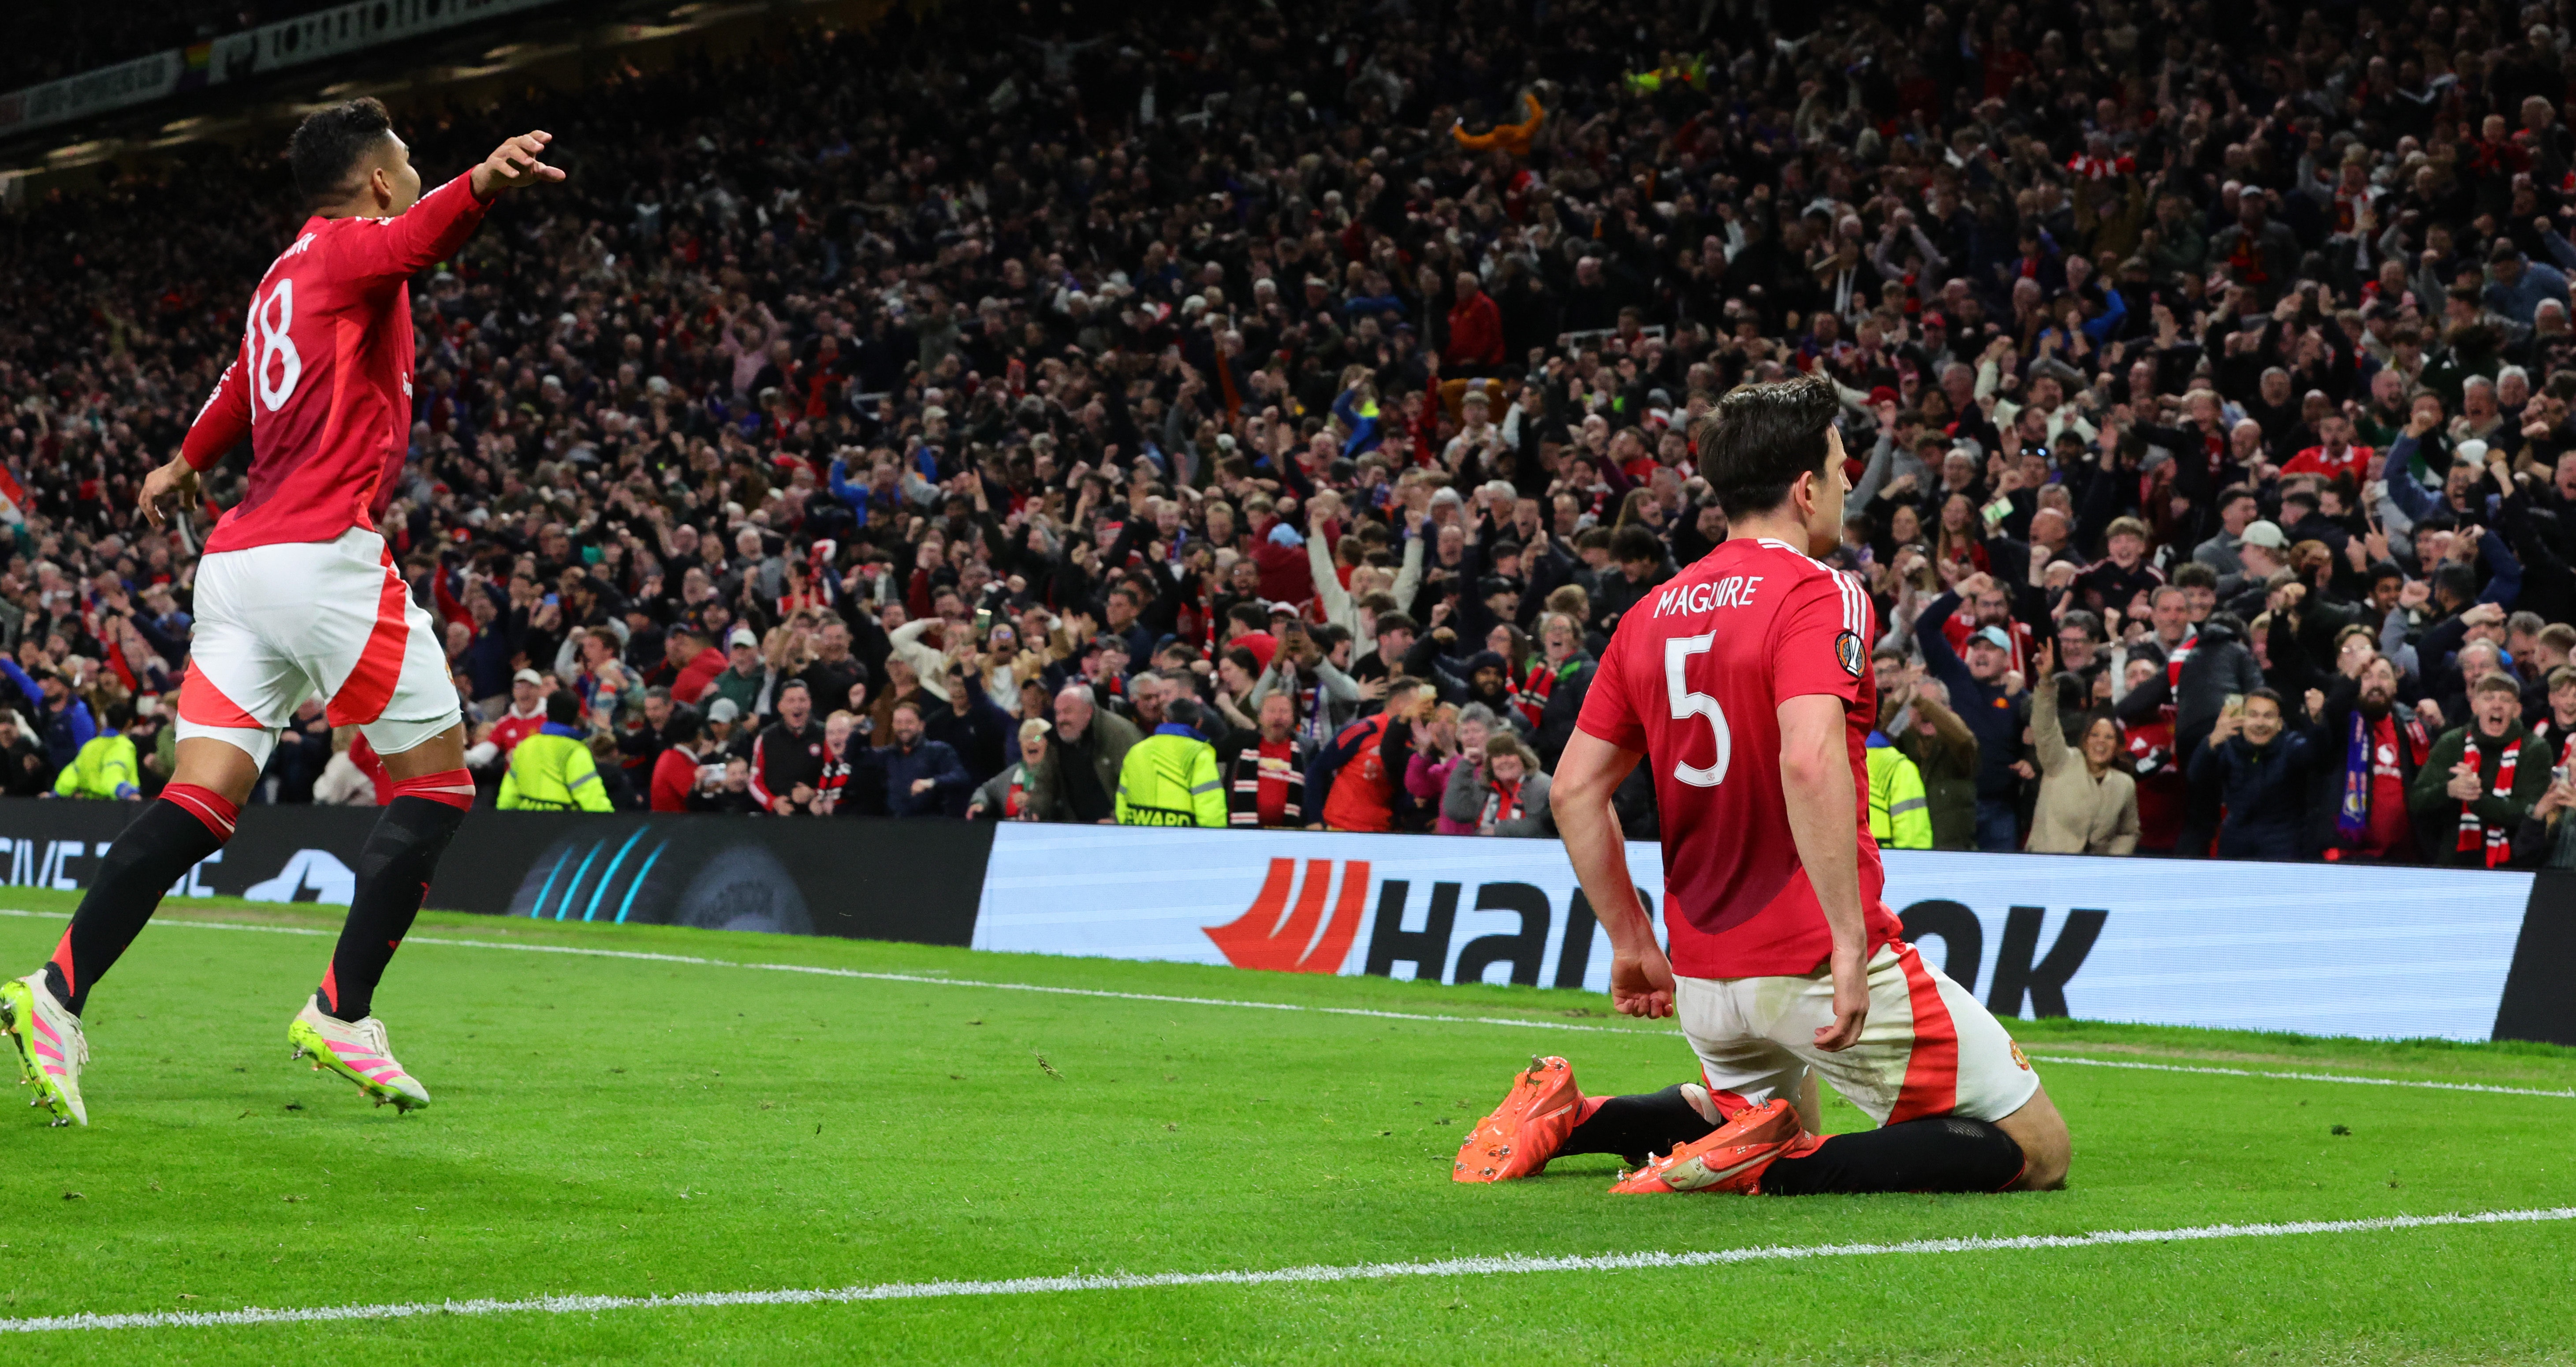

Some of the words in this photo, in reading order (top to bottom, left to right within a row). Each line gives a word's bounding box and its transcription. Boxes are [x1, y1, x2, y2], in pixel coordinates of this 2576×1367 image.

[246, 278, 302, 425] 18
[1653, 576, 1764, 619] MAGUIRE
[1665, 629, 1731, 787] 5
